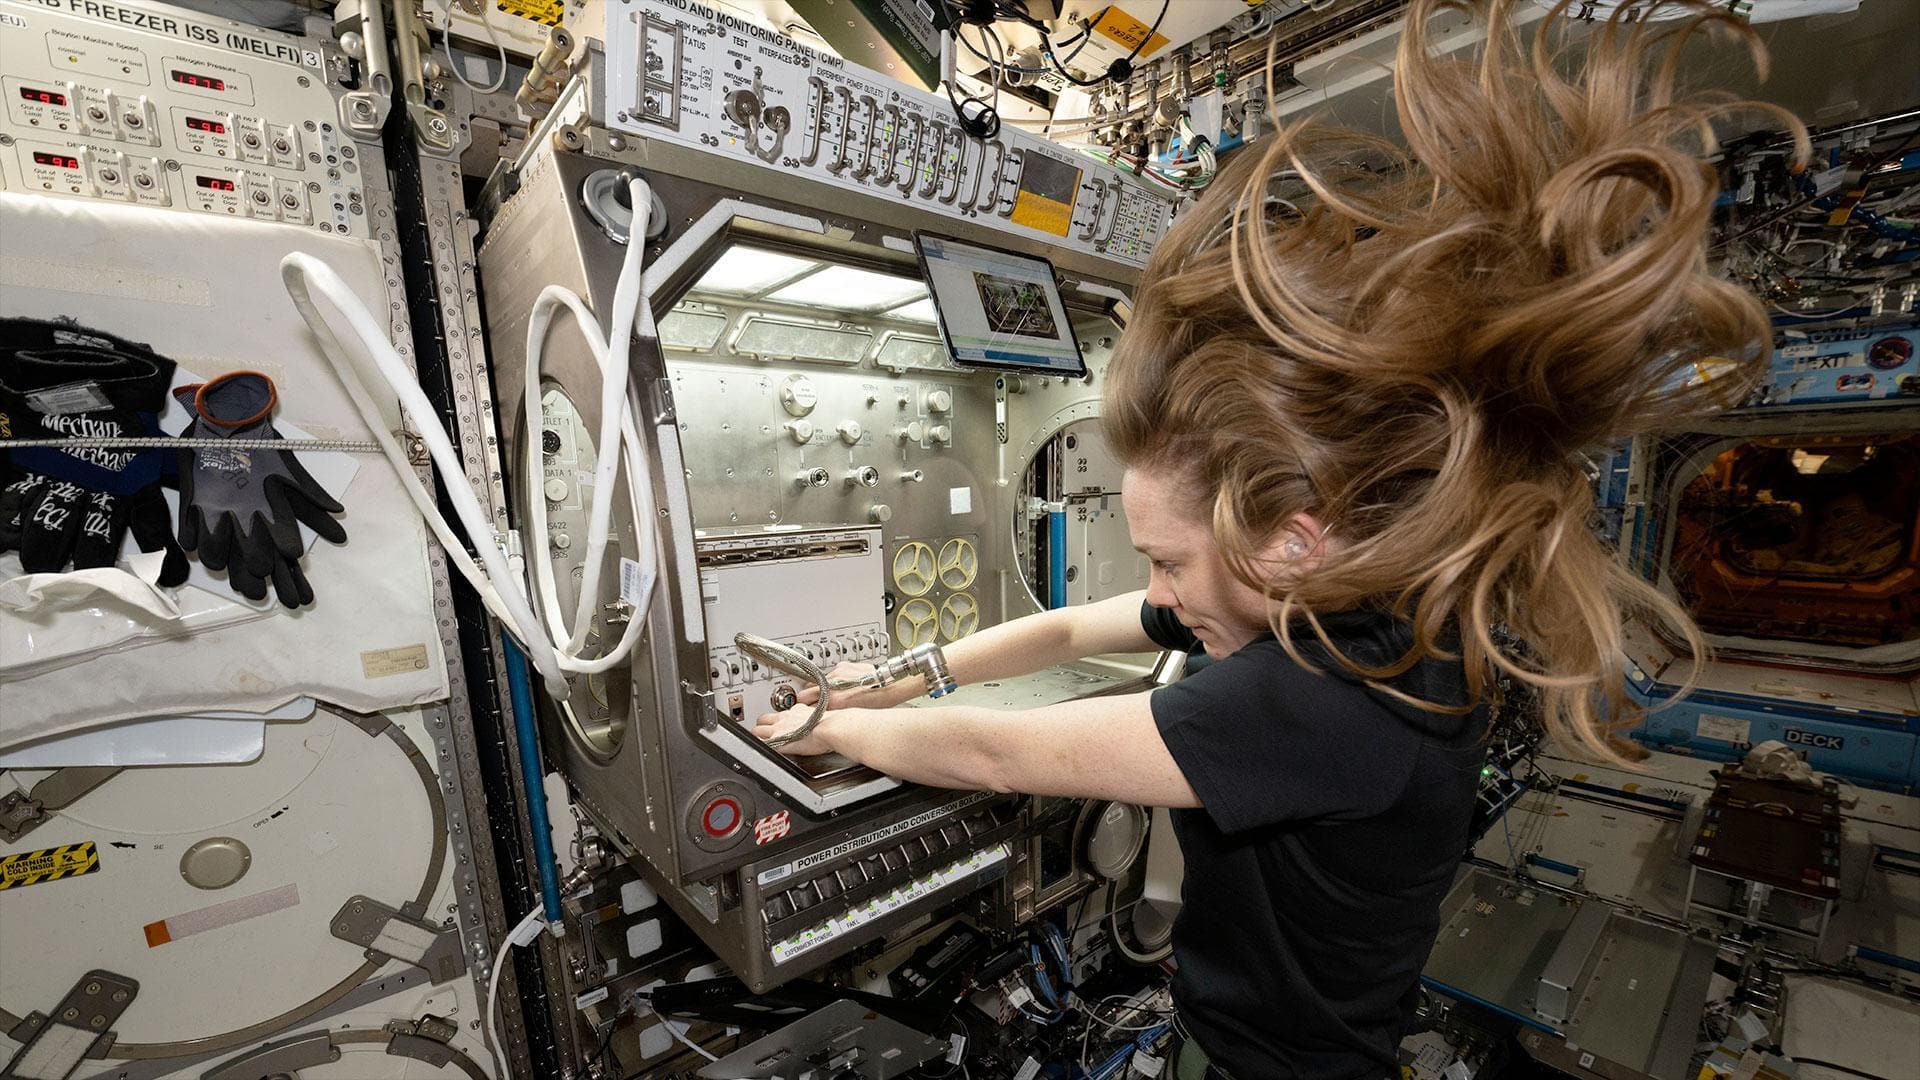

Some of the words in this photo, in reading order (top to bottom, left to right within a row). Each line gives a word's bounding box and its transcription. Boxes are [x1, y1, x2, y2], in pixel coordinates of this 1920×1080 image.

[71, 0, 178, 35] FREEZER
[185, 24, 220, 44] ISS
[226, 33, 300, 64] (MELFI)
[689, 3, 714, 20] AND
[716, 12, 784, 46] MONITORING
[785, 38, 817, 60] PANEL
[818, 51, 844, 70] (CMP)
[732, 35, 749, 49] TEST
[305, 51, 318, 67] 3
[759, 45, 793, 65] INTERFACES
[816, 67, 846, 83] EXPERIMENT
[846, 77, 864, 90] POWER
[863, 85, 884, 98] OUTLETS
[1786, 730, 1843, 749] DECK
[797, 849, 832, 869] POWER
[833, 828, 892, 856] DISTRIBUTION
[892, 820, 910, 833] AND
[910, 802, 958, 827] CONVERSION
[959, 796, 975, 808] BOX
[6, 855, 54, 870] WARNING
[7, 867, 30, 876] COLD
[30, 862, 55, 871] INSIDE
